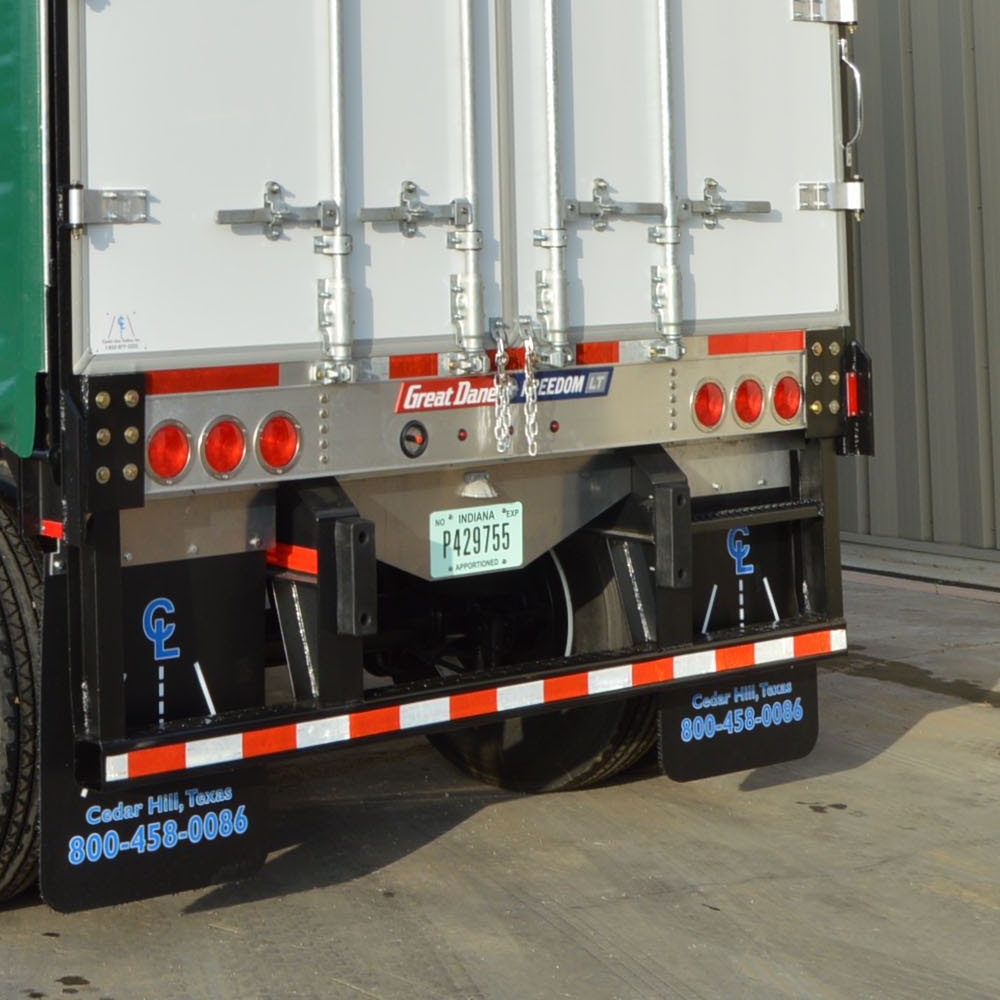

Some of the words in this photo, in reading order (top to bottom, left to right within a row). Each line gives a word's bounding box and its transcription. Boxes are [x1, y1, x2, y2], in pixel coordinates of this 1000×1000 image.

[403, 383, 454, 410] Great
[453, 380, 498, 406] Dane
[587, 373, 606, 390] LT
[435, 518, 446, 527] NO
[458, 510, 496, 524] INDIANA
[506, 508, 520, 518] EXP
[443, 522, 510, 559] P429755
[455, 558, 499, 571] APPORTIONED
[692, 690, 731, 710] Cedar
[733, 683, 760, 703] Hill,
[759, 681, 793, 699] Texas
[680, 697, 804, 743] 800-458-0086
[85, 801, 144, 825] Cedar
[147, 792, 185, 816] Hill,
[185, 786, 233, 809] Texas
[67, 805, 249, 866] 800-458-0086
